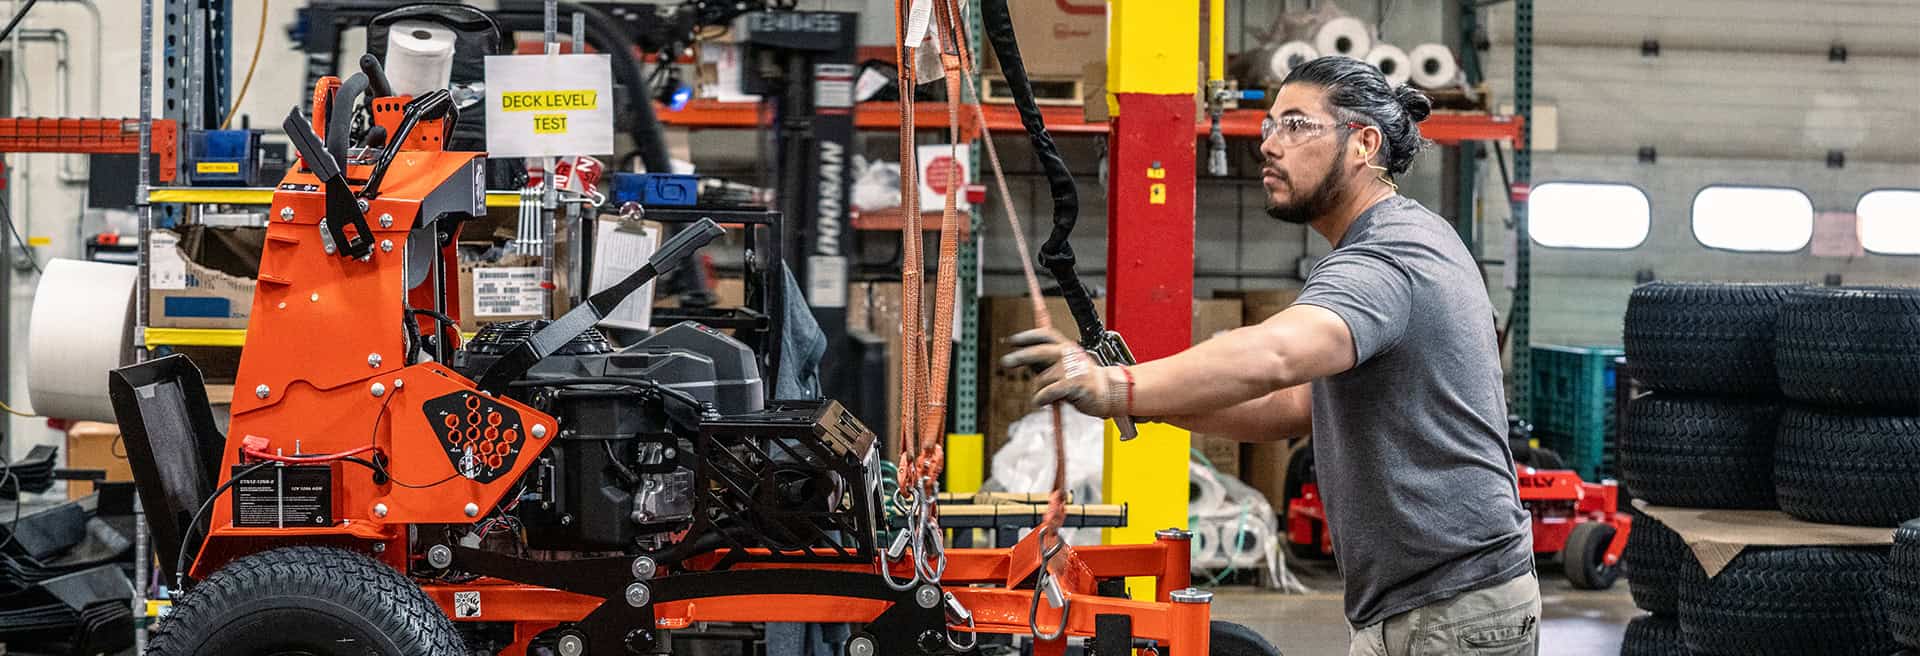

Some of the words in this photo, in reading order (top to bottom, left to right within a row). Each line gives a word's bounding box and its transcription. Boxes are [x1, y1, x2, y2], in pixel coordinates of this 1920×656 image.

[502, 95, 541, 108] DECK
[546, 94, 588, 107] LEVEL
[533, 117, 568, 130] TEST
